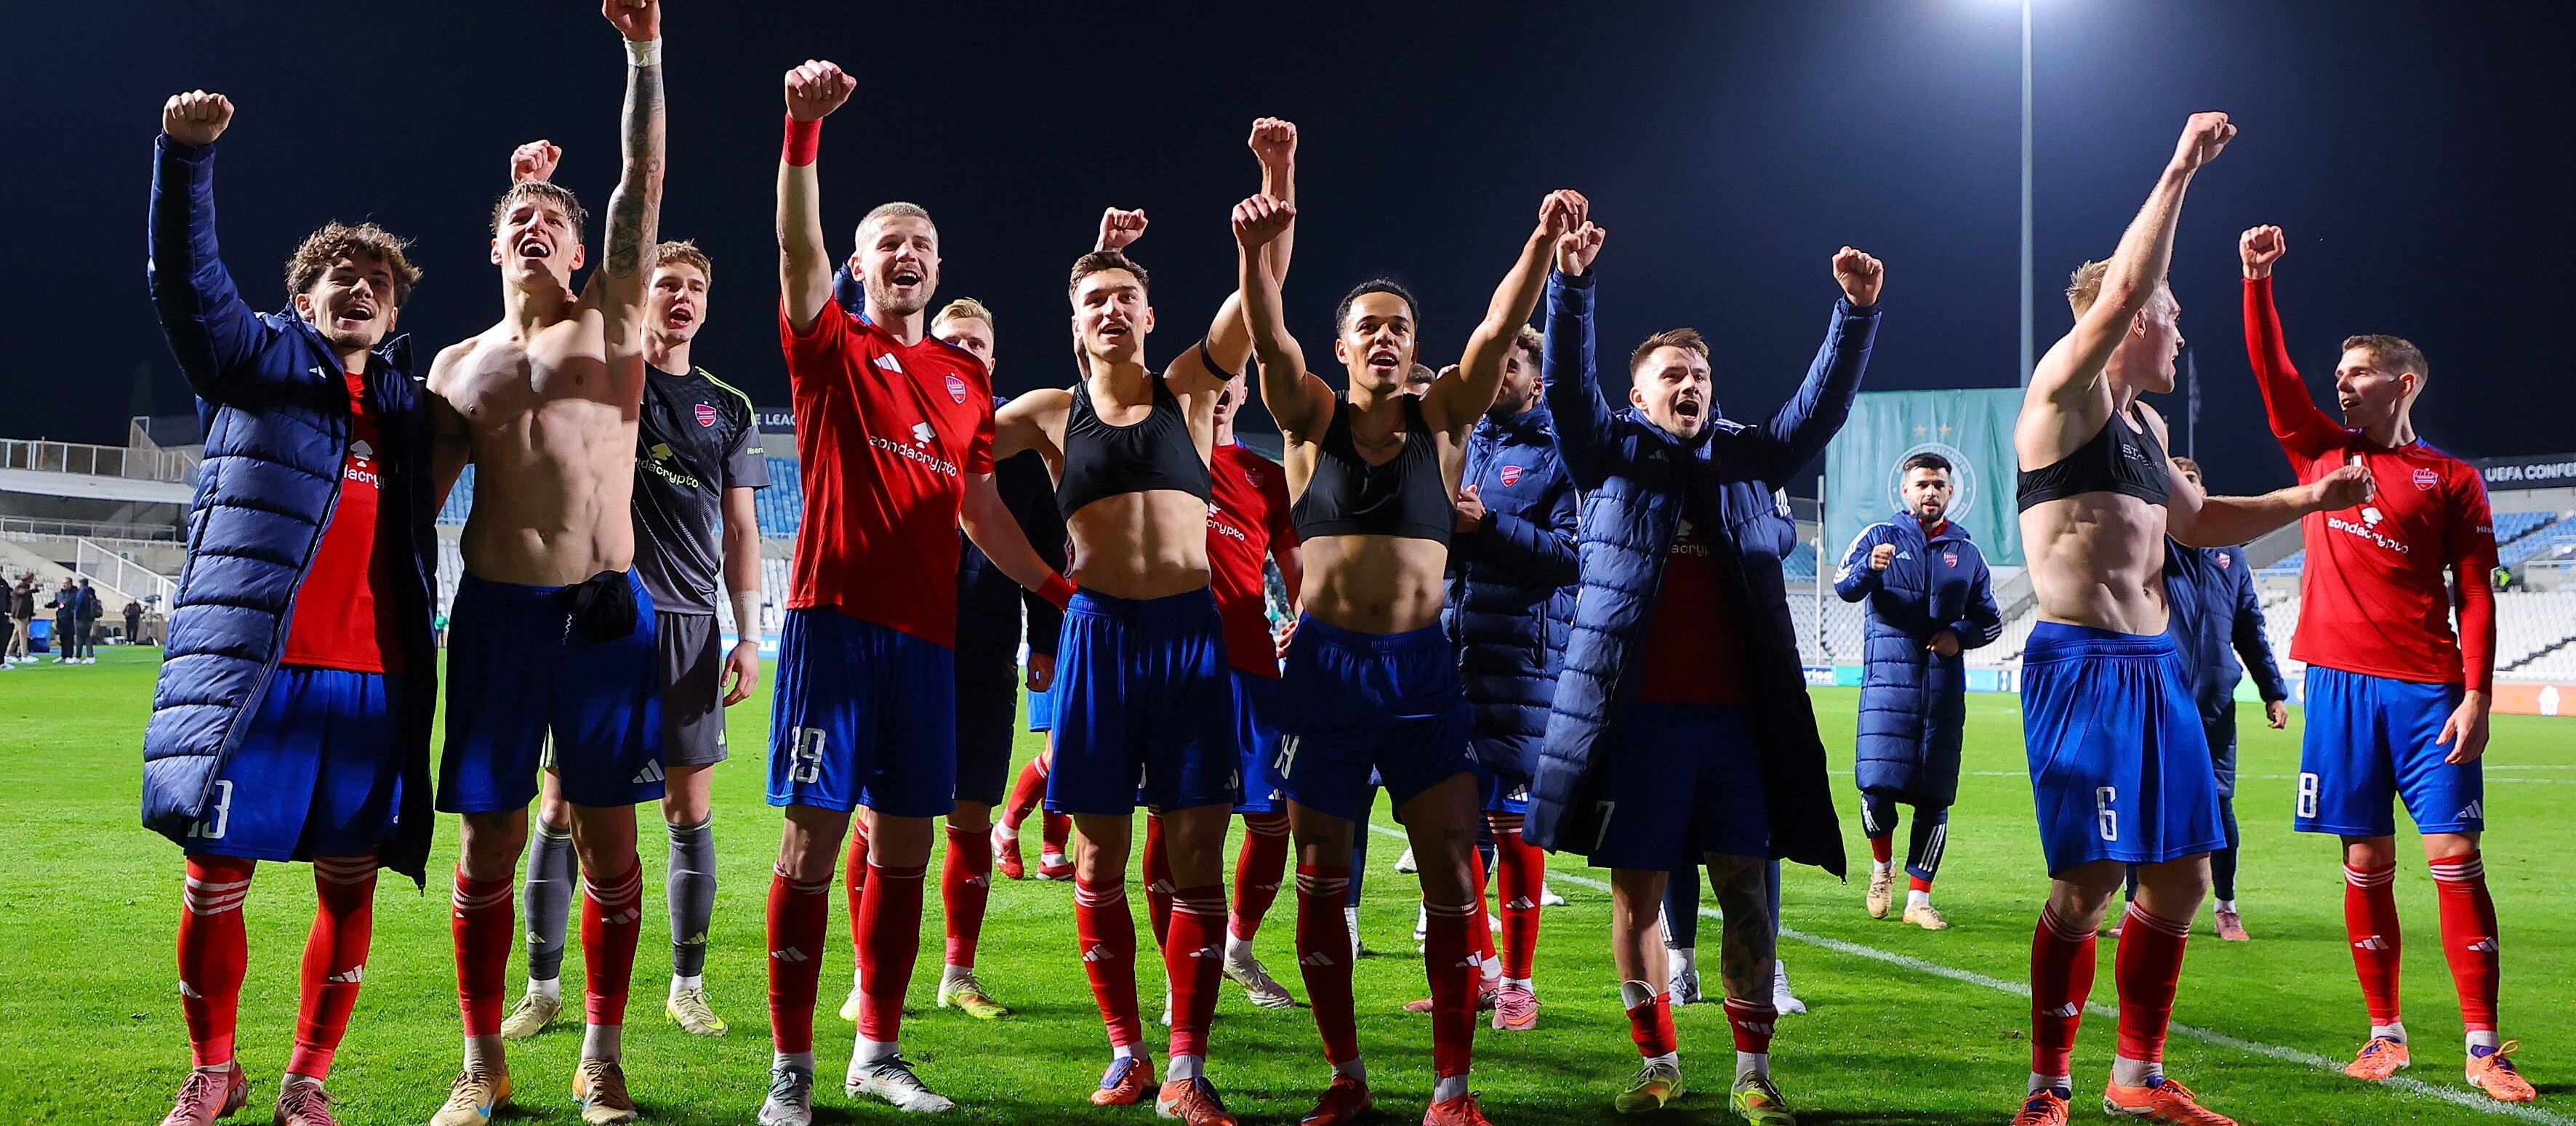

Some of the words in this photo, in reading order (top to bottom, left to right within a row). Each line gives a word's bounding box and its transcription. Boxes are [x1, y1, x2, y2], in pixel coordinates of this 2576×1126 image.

[869, 435, 957, 477] zondacrypto
[2484, 466, 2524, 482] UEFA
[1206, 519, 1245, 541] crypto
[2327, 517, 2409, 554] zondacrypto
[187, 779, 233, 839] 3
[2096, 787, 2117, 842] 6
[2297, 772, 2319, 819] 8
[1594, 800, 1615, 851] 7
